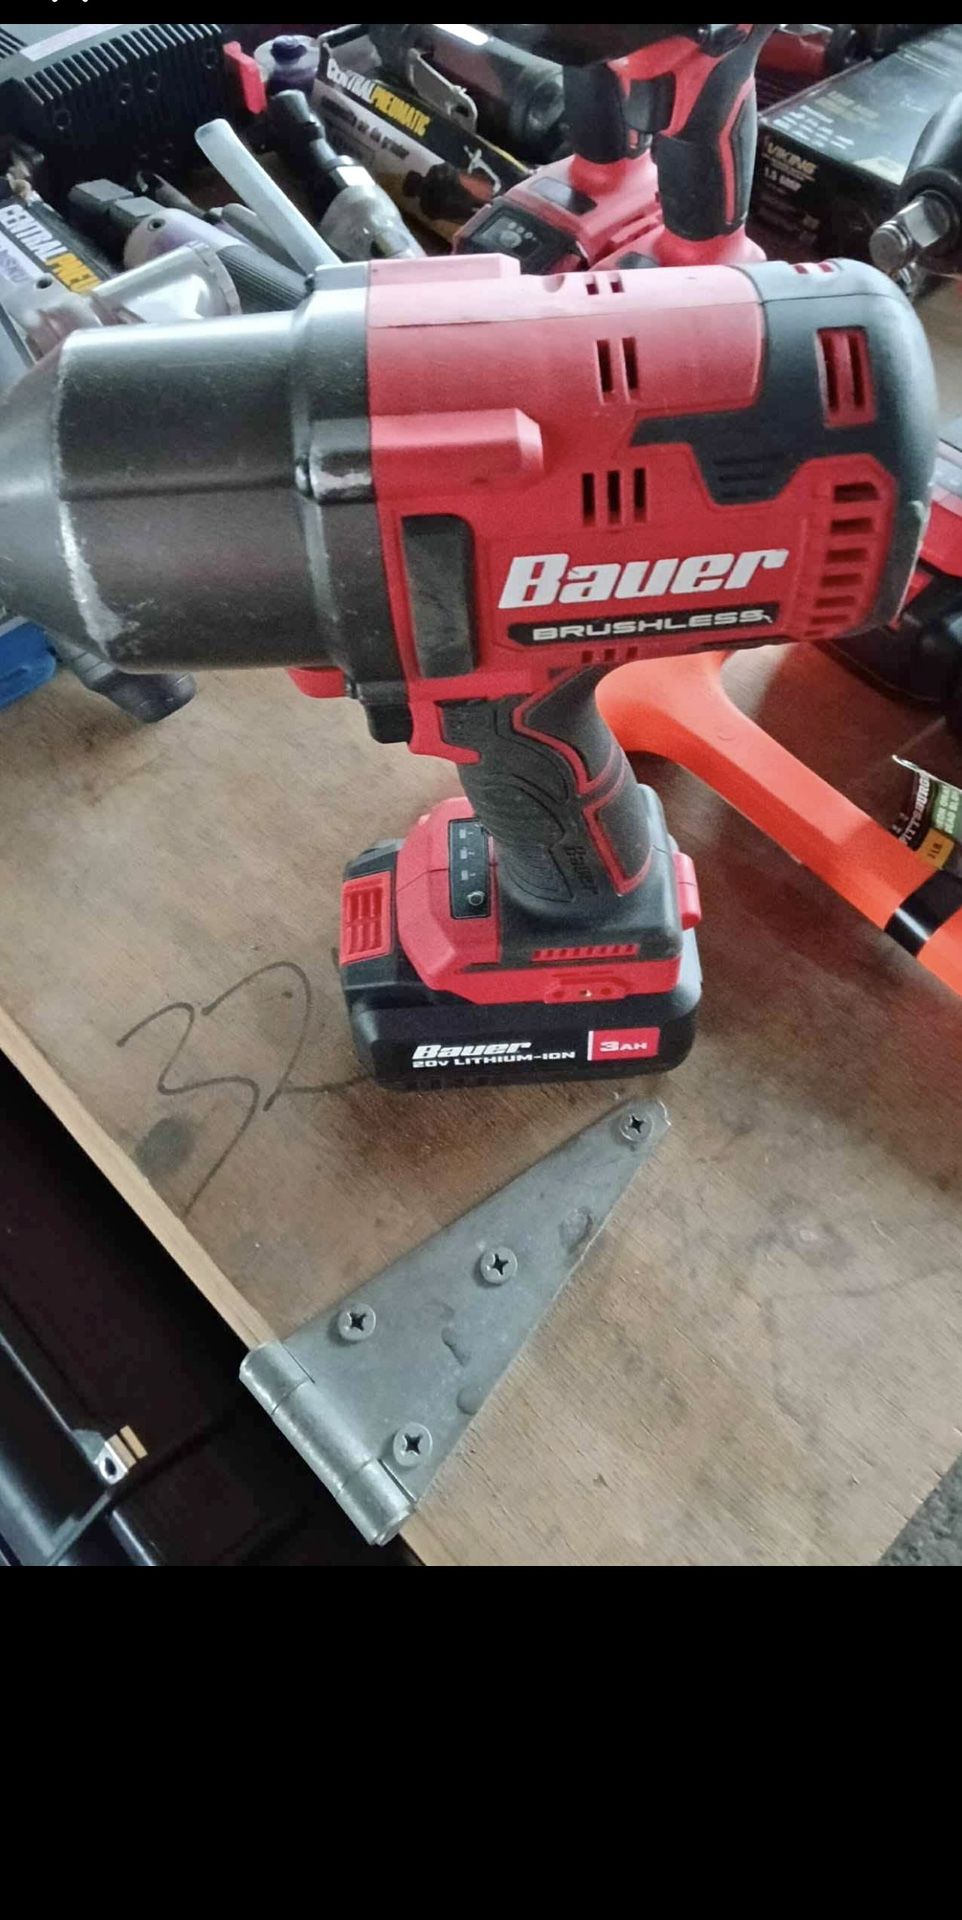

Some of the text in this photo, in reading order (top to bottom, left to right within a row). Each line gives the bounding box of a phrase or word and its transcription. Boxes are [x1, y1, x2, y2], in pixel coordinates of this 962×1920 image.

[498, 548, 789, 609] Bauer
[532, 609, 767, 641] BRUSHLESS
[412, 1041, 532, 1060] Bauer
[599, 1041, 649, 1052] 3AH
[454, 1051, 576, 1066] LITHIUM-ION
